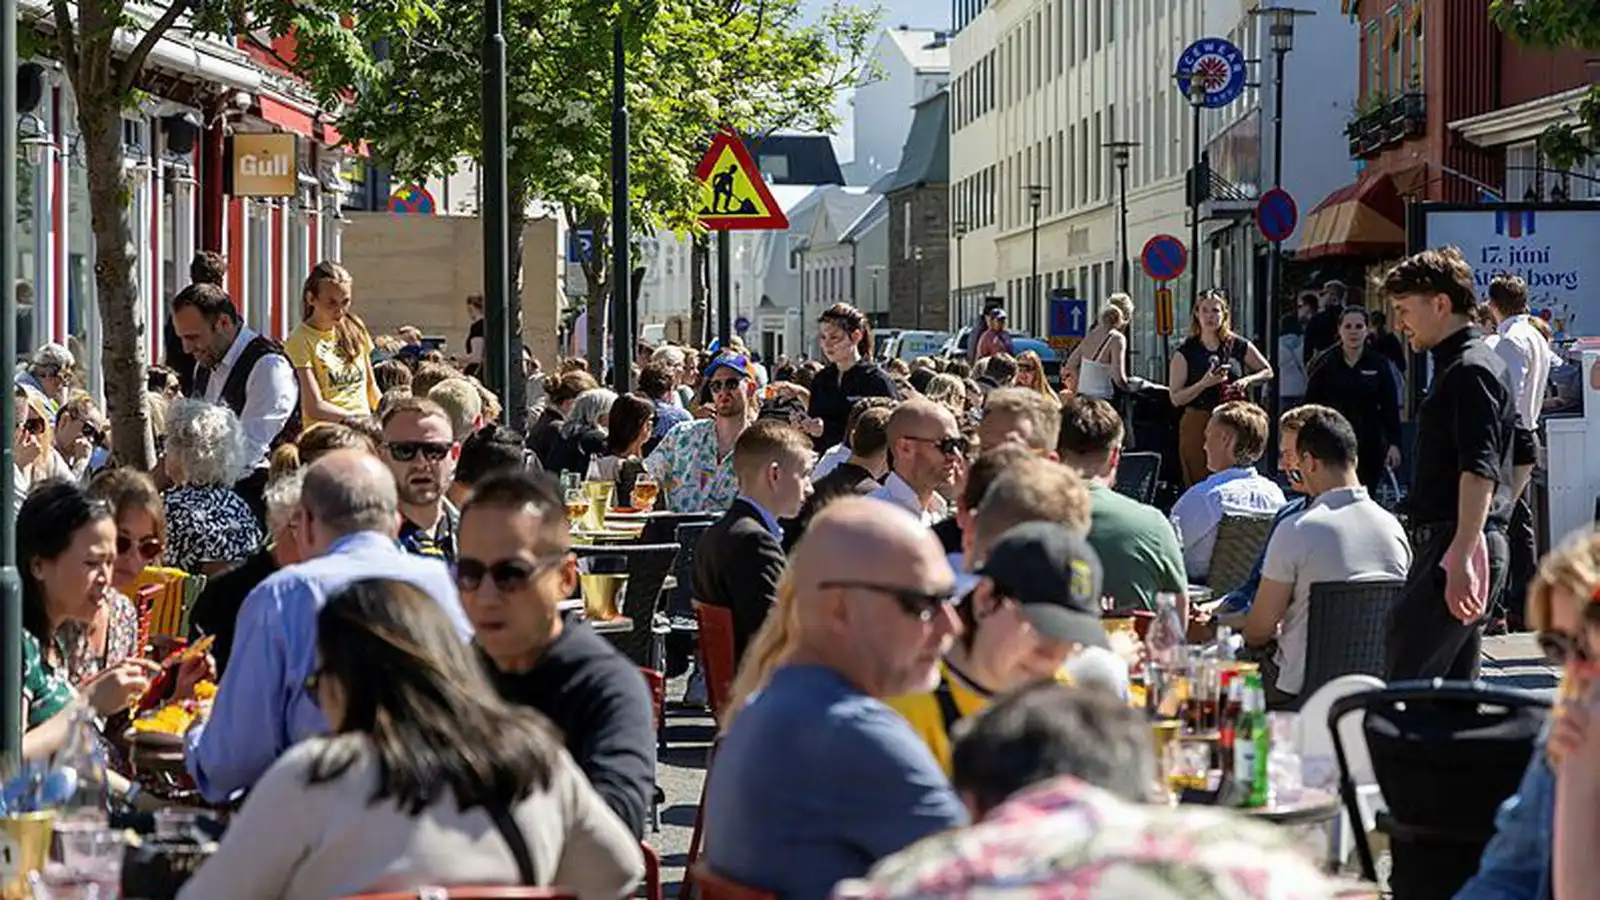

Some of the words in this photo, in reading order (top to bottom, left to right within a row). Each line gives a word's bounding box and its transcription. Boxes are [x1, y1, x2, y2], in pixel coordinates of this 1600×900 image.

[1181, 42, 1242, 75] ICEWEAR
[240, 154, 288, 176] Gull
[1482, 246, 1503, 263] 17.
[1509, 245, 1551, 267] júní
[1527, 267, 1578, 291] borg
